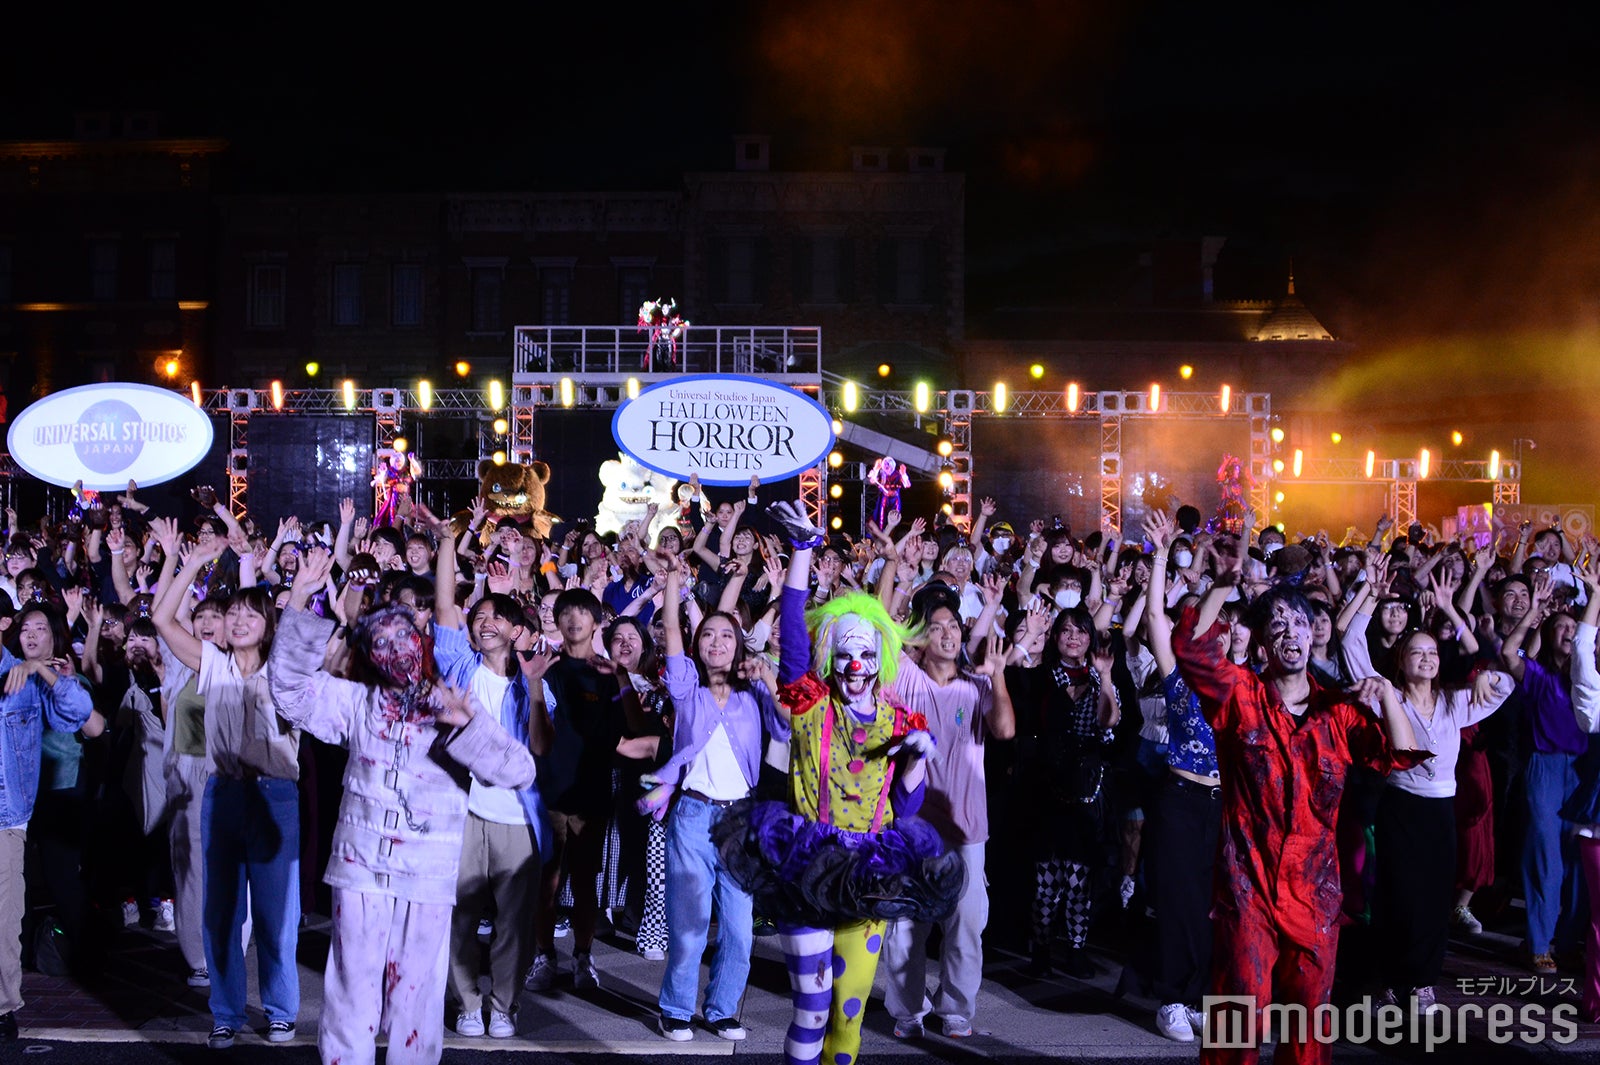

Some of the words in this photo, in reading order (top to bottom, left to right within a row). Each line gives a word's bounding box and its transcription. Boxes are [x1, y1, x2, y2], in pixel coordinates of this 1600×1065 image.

[669, 390, 711, 401] Universal
[714, 391, 748, 402] Studios
[750, 393, 776, 404] Japan
[659, 401, 789, 423] HALLOWEEN
[33, 421, 117, 446] UNIVERSAL
[122, 421, 188, 443] STUDIOS
[648, 419, 799, 463] HORROR
[83, 443, 134, 455] JAPAN
[688, 451, 763, 471] NIGHTS
